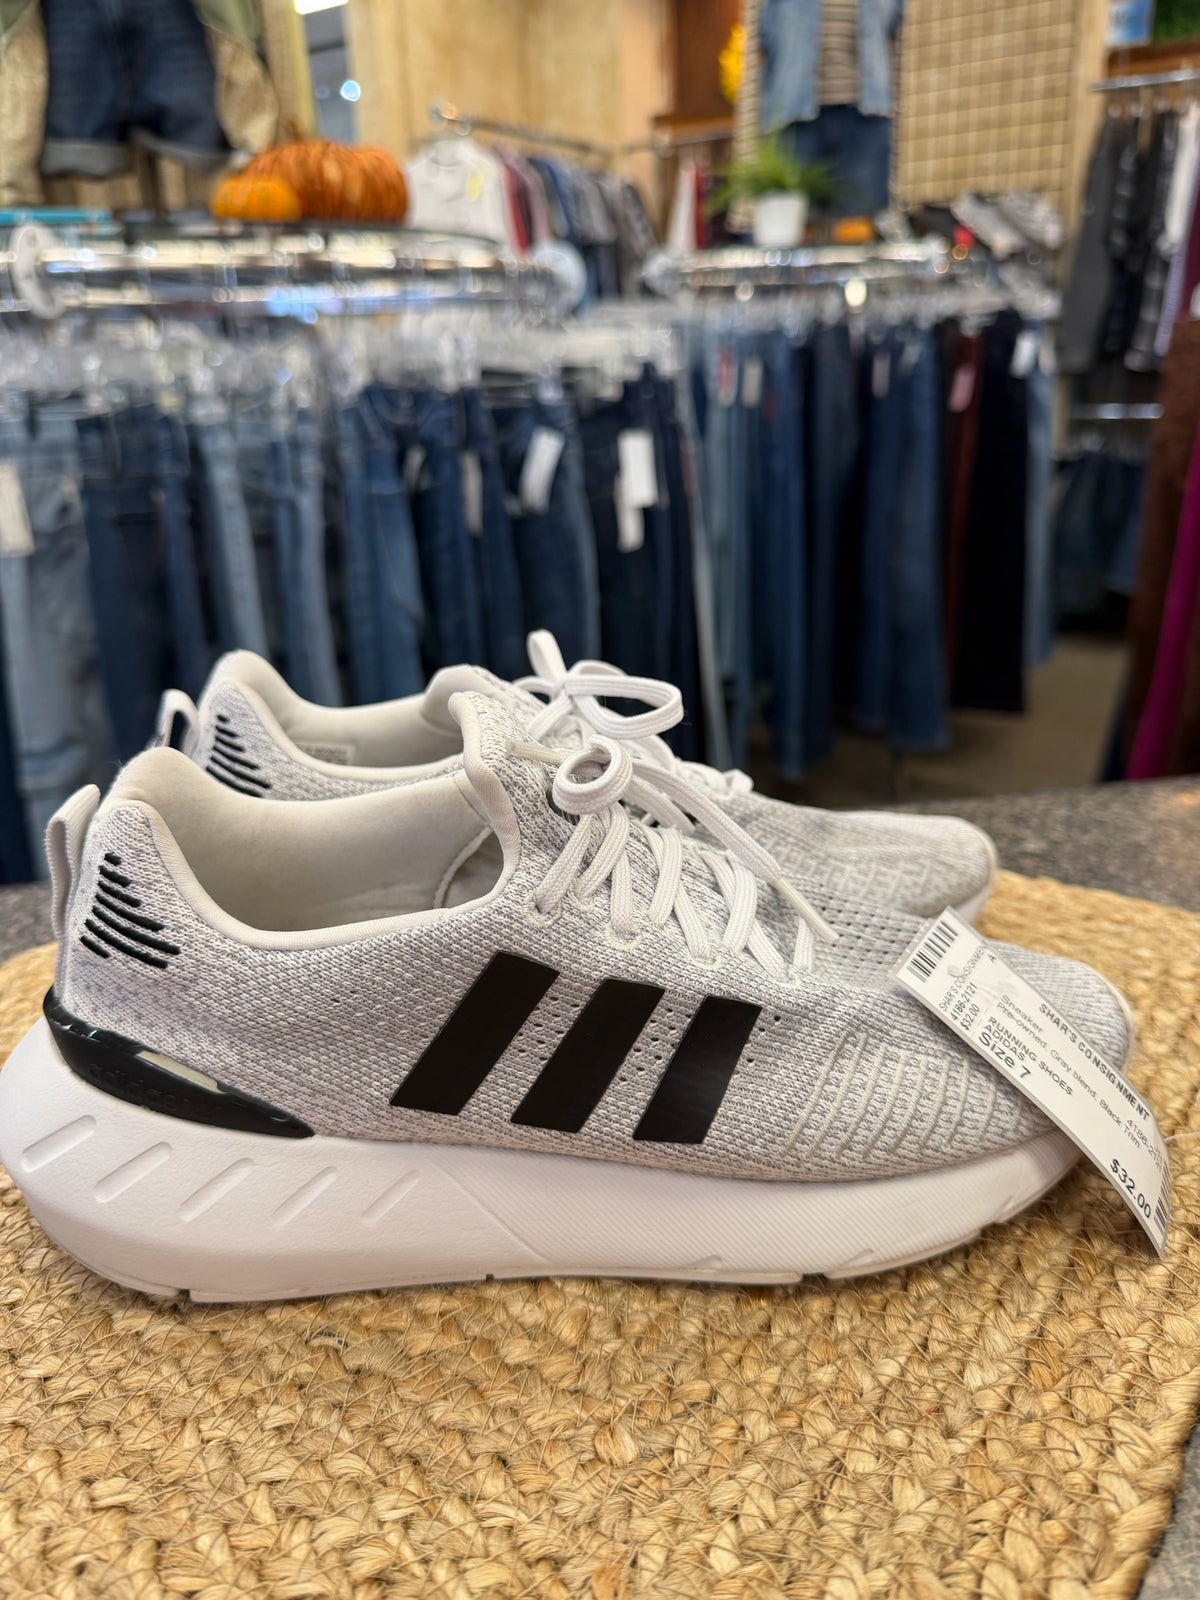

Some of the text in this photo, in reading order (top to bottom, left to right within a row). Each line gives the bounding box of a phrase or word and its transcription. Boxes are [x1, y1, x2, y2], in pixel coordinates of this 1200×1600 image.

[951, 982, 978, 1021] 4186-2121
[960, 1004, 980, 1031] $32.00
[1001, 994, 1044, 1034] Sneaker
[984, 1024, 1026, 1061] ADIDAS
[1039, 1004, 1077, 1043] SHAR'S
[978, 1032, 1032, 1079] Size 7
[988, 1016, 1073, 1096] RUNNING SHOES
[1050, 1049, 1072, 1072] Gray
[1099, 1099, 1122, 1127] Black
[1110, 1158, 1152, 1219] $32.00
